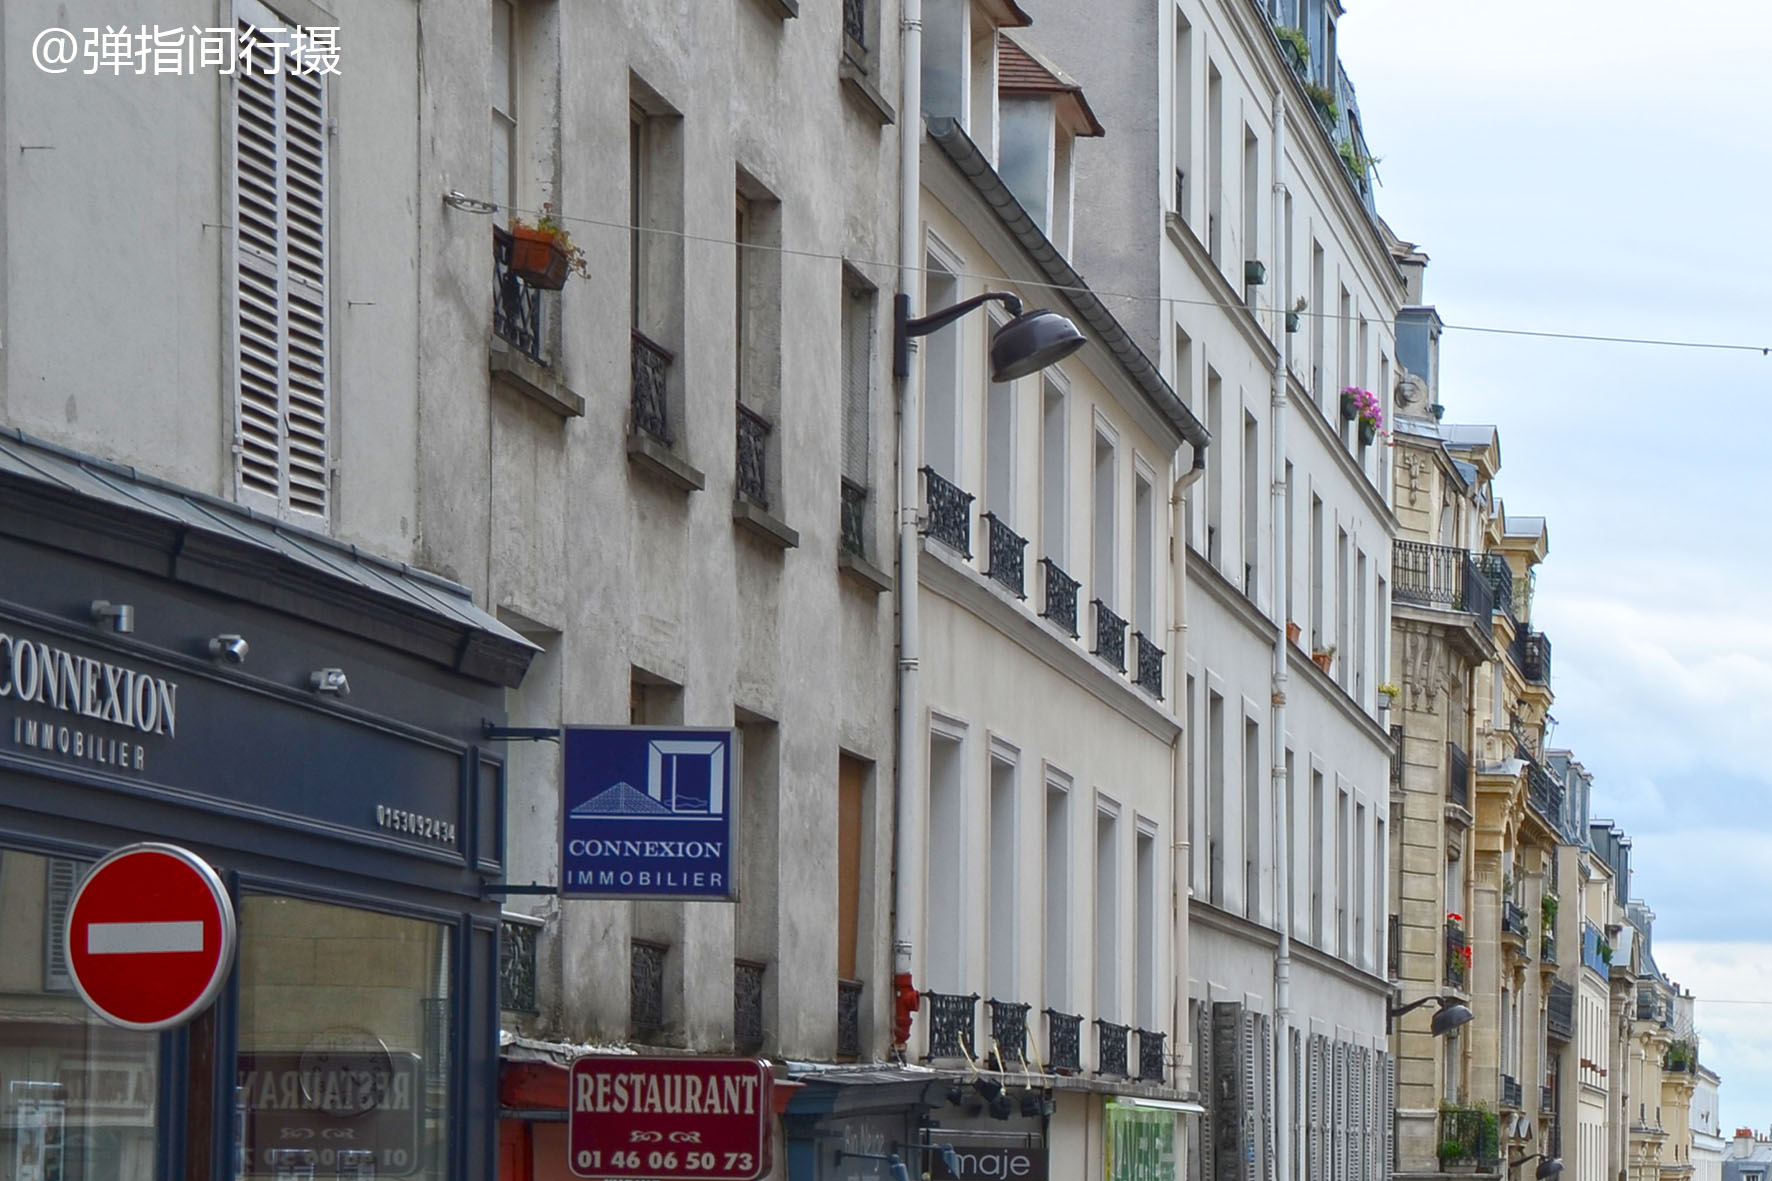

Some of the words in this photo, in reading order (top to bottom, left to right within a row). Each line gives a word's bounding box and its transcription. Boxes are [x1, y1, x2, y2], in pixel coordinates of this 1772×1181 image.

[0, 633, 178, 739] CONNEXION
[14, 716, 145, 771] IMMOBILIER
[376, 804, 456, 844] 0153092434
[568, 839, 723, 858] CONNEXION
[567, 870, 723, 887] IMMOBILIER
[576, 1073, 758, 1115] RESTAURANT
[577, 1150, 601, 1169] 01
[611, 1151, 641, 1169] 46
[648, 1151, 678, 1169] 06
[685, 1152, 716, 1170] 50
[724, 1153, 753, 1170] 73
